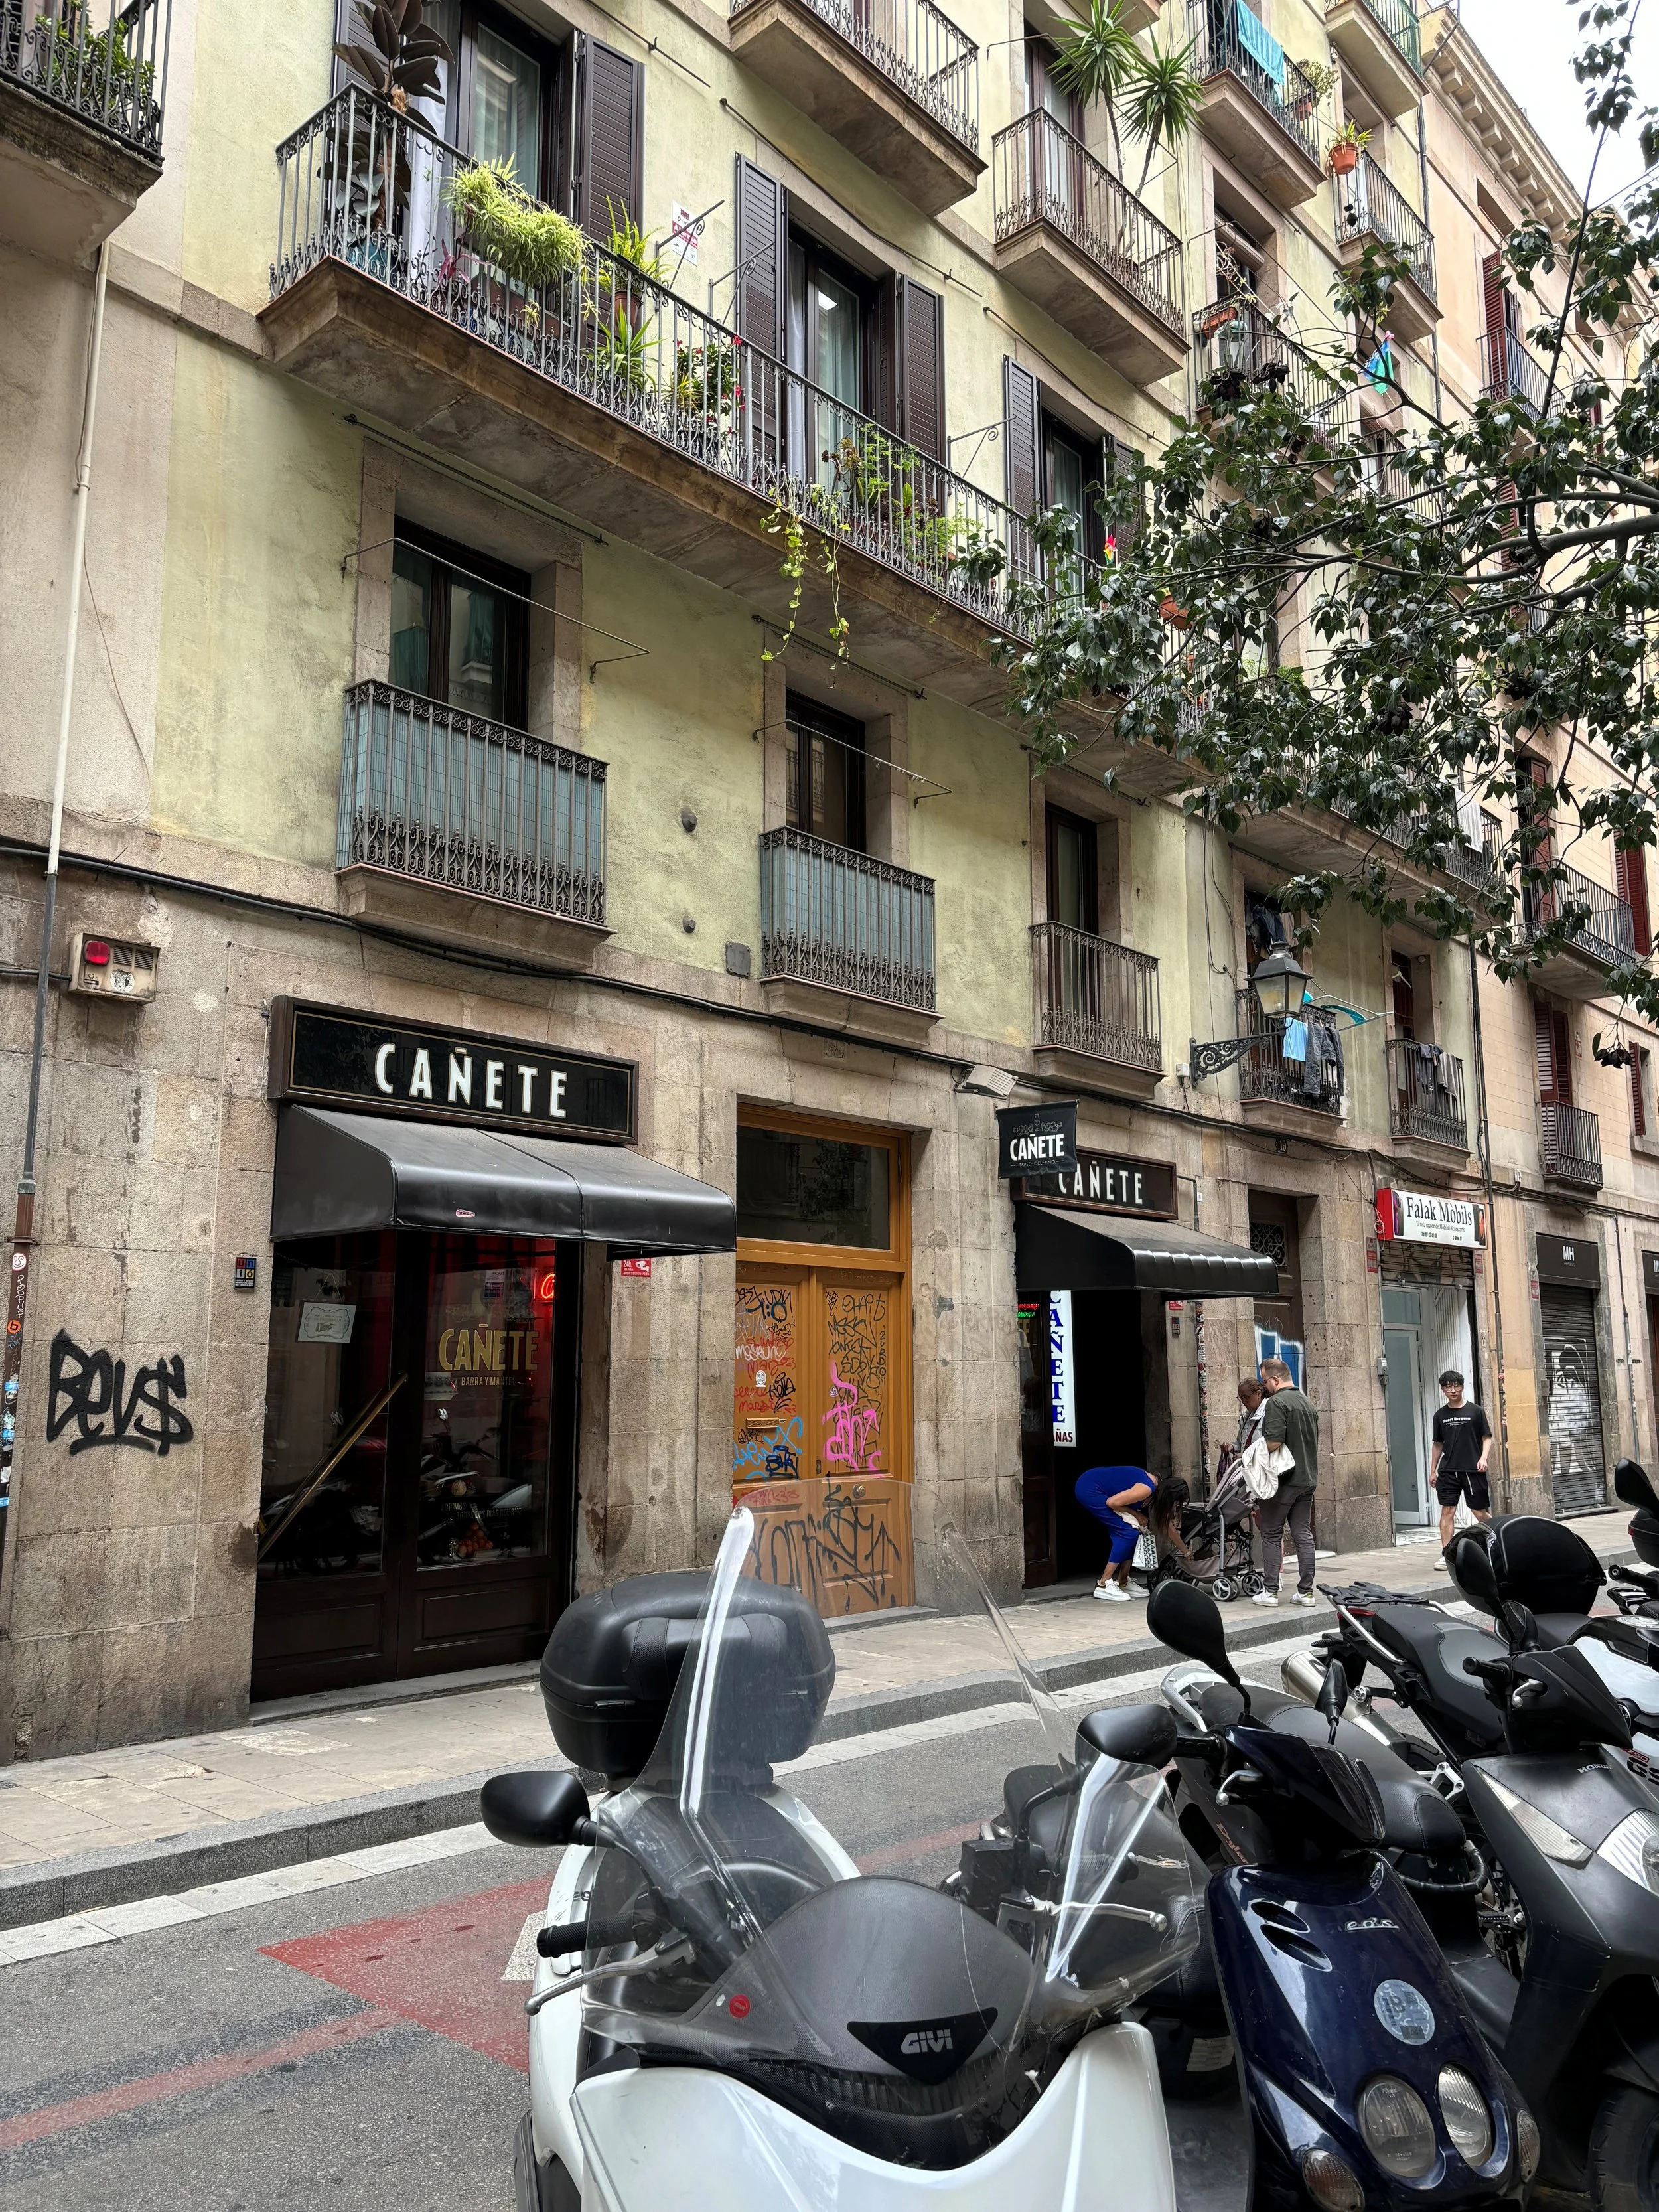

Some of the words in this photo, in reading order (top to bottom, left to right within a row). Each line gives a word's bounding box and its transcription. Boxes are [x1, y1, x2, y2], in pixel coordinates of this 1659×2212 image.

[374, 1042, 568, 1119] CAÑETE
[1009, 1134, 1064, 1161] CAÑETE
[1406, 1197, 1437, 1220] Falak
[1438, 1201, 1472, 1225] Mòbils
[1563, 1246, 1575, 1261] MH
[1654, 1260, 1659, 1272] M
[439, 1323, 540, 1371] CAÑETE
[461, 1377, 483, 1386] BARRA
[484, 1377, 489, 1386] Y
[1054, 1428, 1073, 1443] ÑAS
[1577, 1763, 1612, 1774] HONDA
[901, 2029, 954, 2055] GIVI
